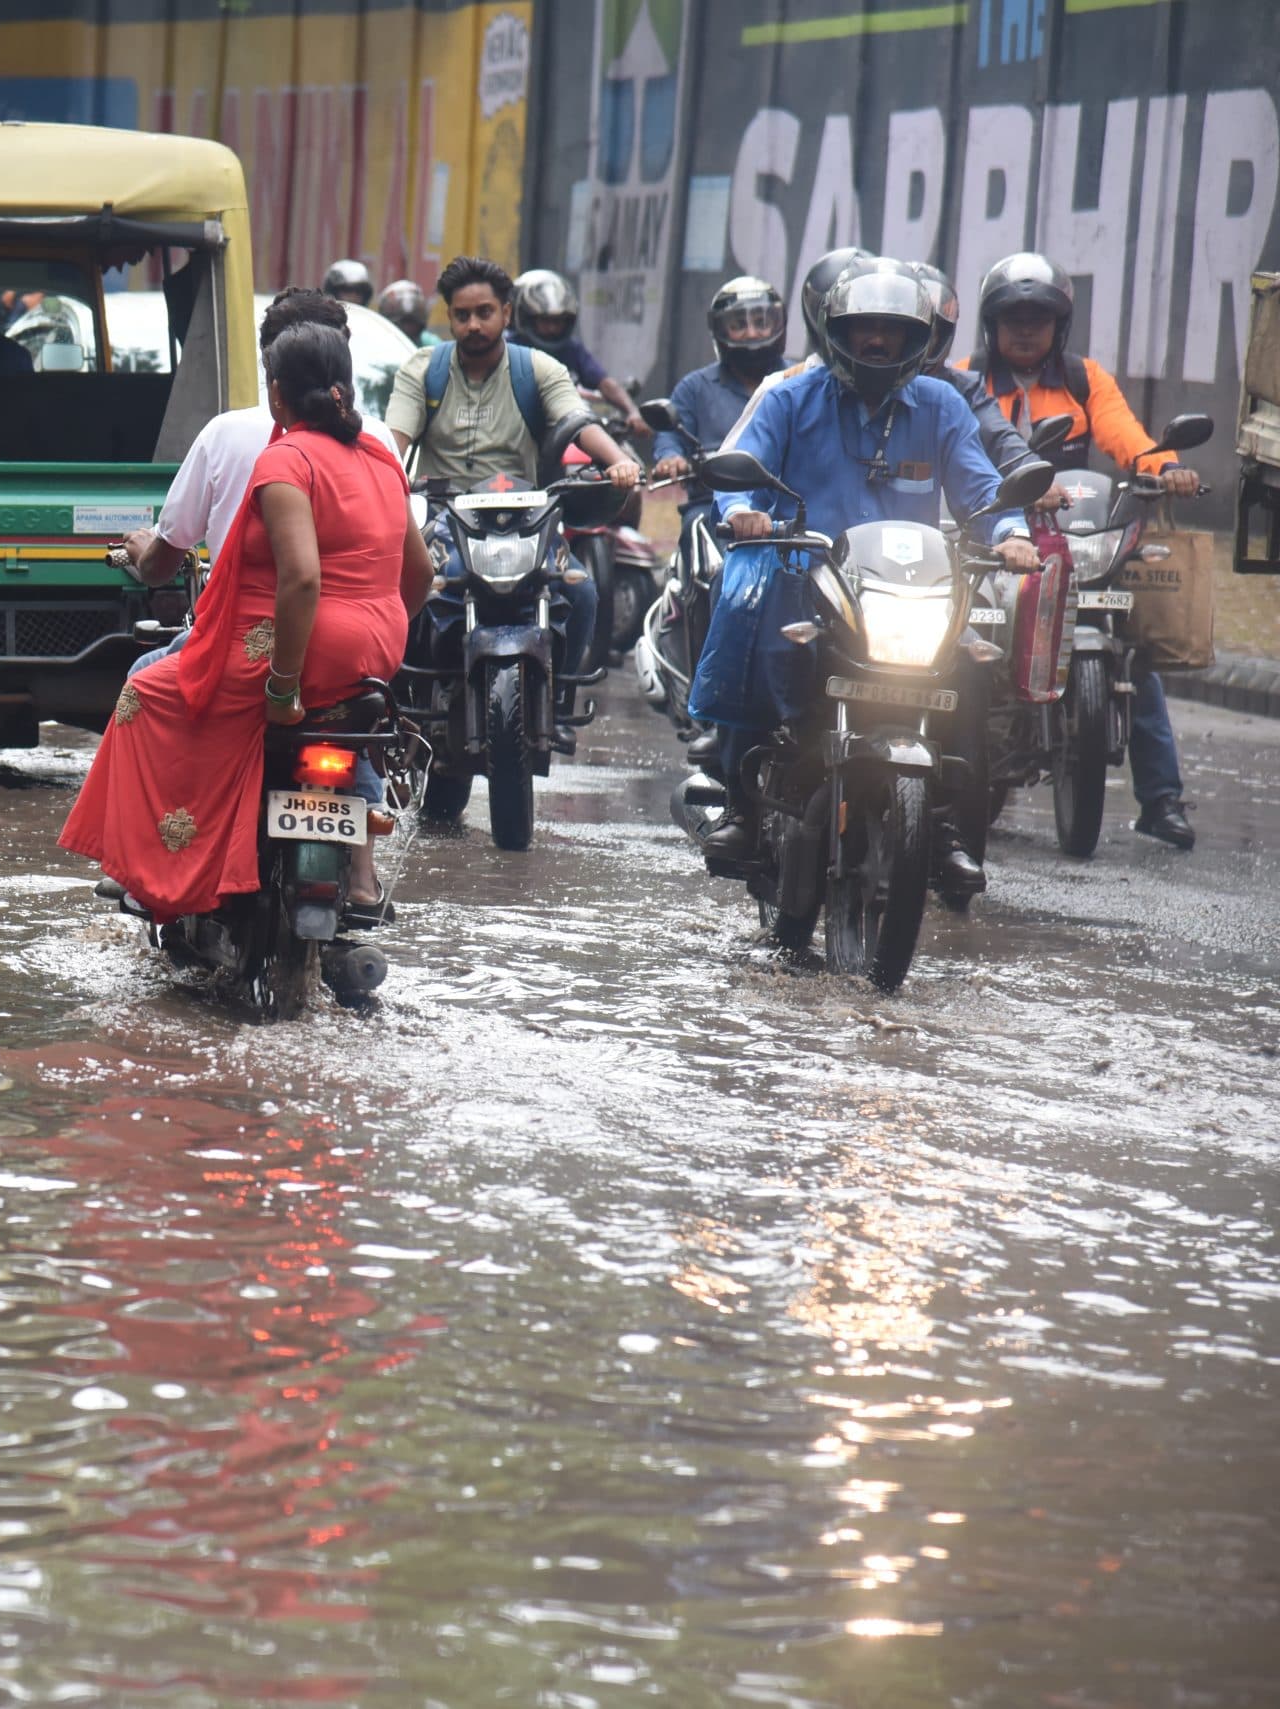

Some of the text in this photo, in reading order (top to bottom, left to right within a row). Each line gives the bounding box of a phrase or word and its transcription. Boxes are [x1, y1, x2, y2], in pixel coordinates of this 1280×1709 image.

[1147, 569, 1182, 583] STEEL
[283, 798, 351, 816] JH05BS
[278, 813, 356, 837] 0166
